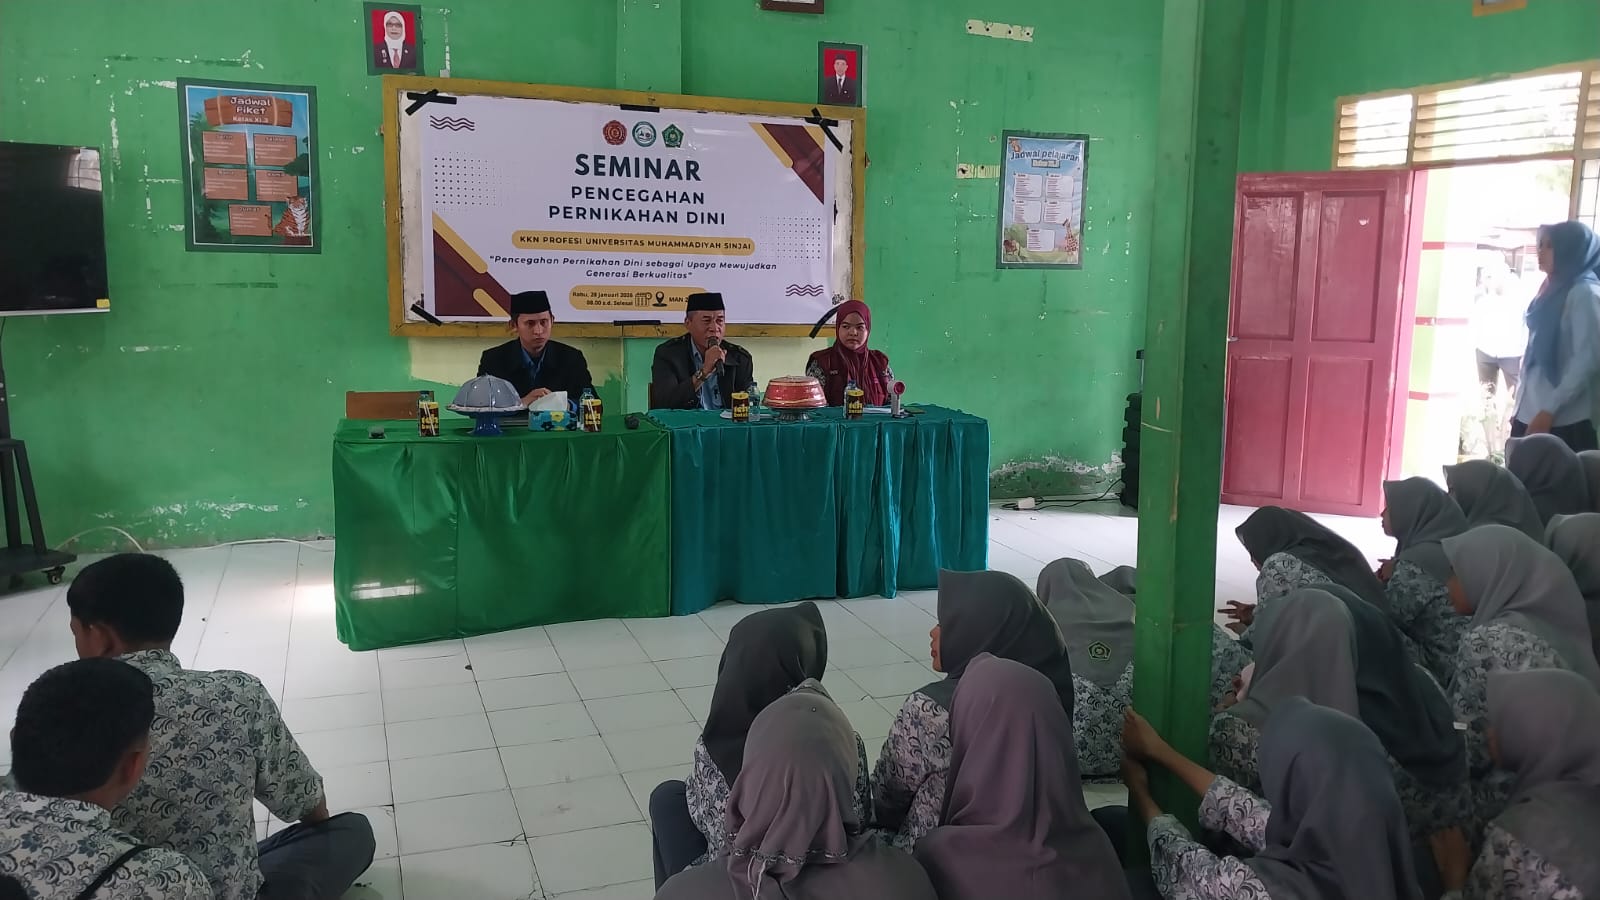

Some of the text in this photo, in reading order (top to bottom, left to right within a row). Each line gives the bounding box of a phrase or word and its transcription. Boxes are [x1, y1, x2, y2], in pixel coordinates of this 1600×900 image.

[230, 96, 271, 106] Jadwal
[236, 106, 266, 115] Piket
[1010, 149, 1080, 162] Jadwal pelajaran
[574, 153, 702, 181] SEMINAR
[571, 186, 704, 204] PENCEGAHAN
[549, 205, 725, 225] PERNIKAHAN DINI
[543, 236, 582, 245] PROFESI
[585, 238, 645, 246] UNIVERSITAS
[648, 240, 721, 249] MUHAMMADIYAH
[563, 257, 620, 266] Pernikahan
[623, 258, 643, 267] Dini
[646, 260, 684, 269] sebagai
[687, 261, 716, 269] Upaya
[720, 262, 777, 271] Mewujudkan
[586, 269, 629, 278] Generasi
